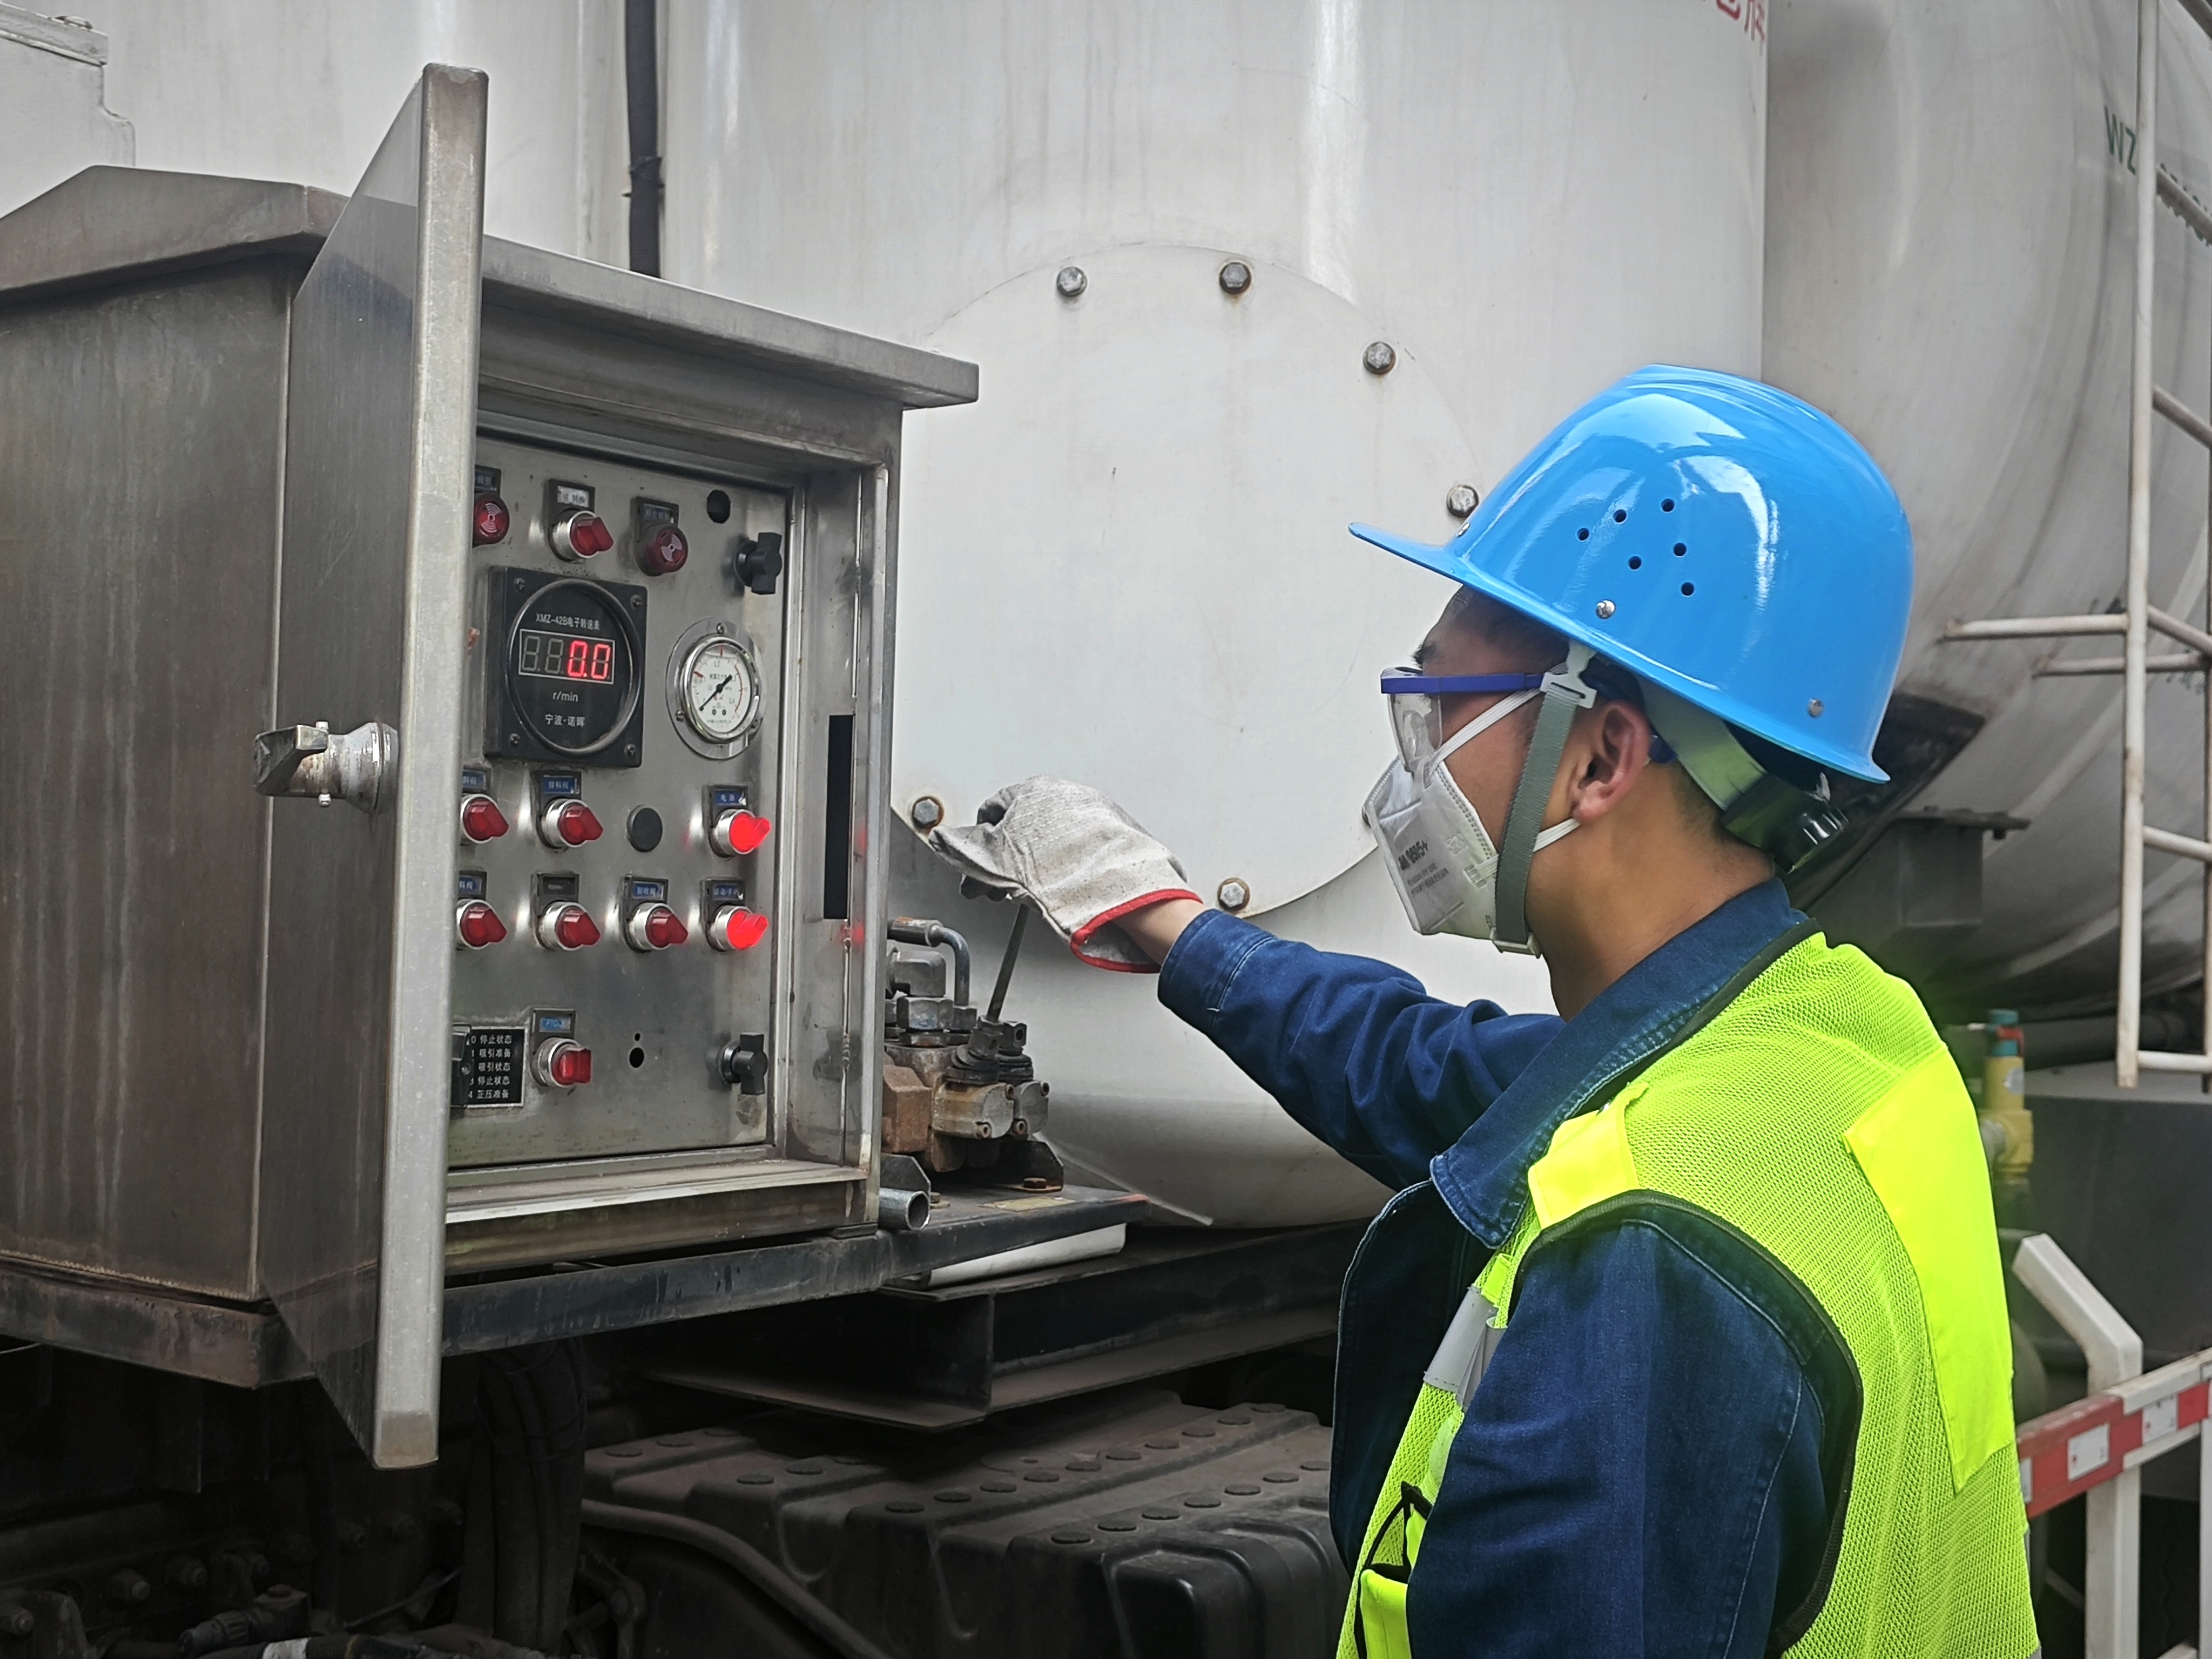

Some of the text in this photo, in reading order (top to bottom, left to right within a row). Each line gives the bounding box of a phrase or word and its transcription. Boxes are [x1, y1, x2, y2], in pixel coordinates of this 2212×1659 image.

[552, 691, 579, 702] r/min
[480, 1035, 512, 1044] 停止状态
[479, 1049, 511, 1057] 吸引准备
[478, 1062, 511, 1071] 吸引状态
[477, 1076, 510, 1085] 停止状态
[476, 1090, 509, 1098] 正压准备
